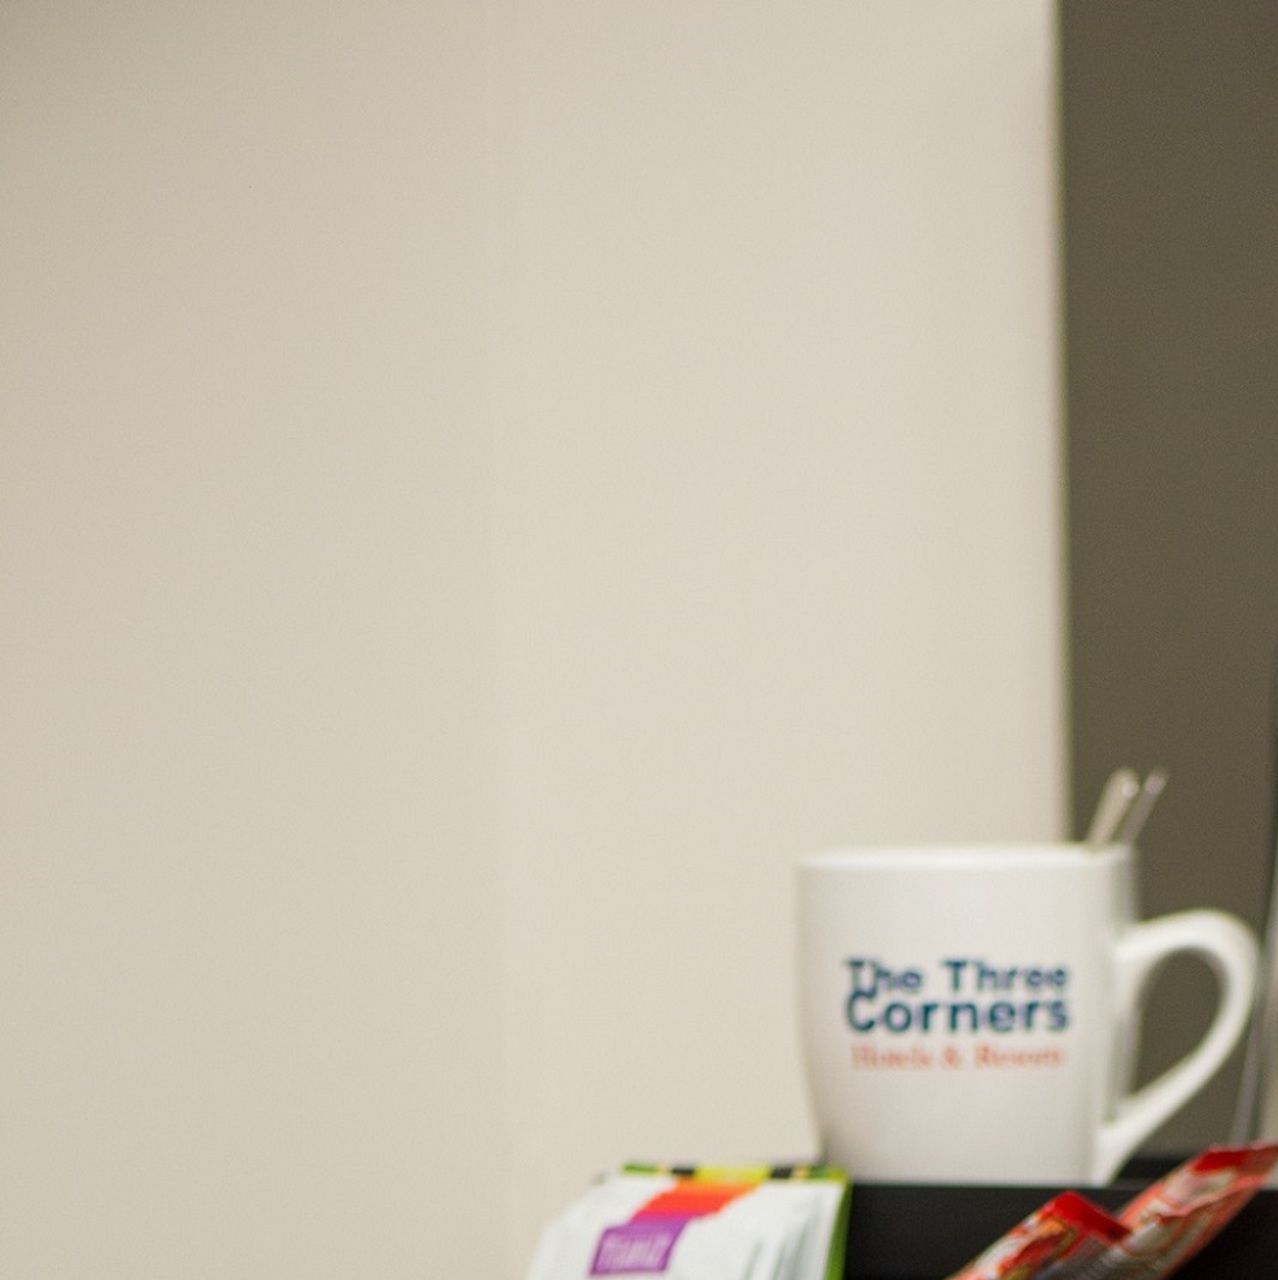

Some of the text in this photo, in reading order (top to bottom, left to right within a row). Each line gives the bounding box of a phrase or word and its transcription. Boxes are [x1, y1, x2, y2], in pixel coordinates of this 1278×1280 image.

[846, 958, 1068, 993] The Three
[847, 989, 1069, 1033] Corners
